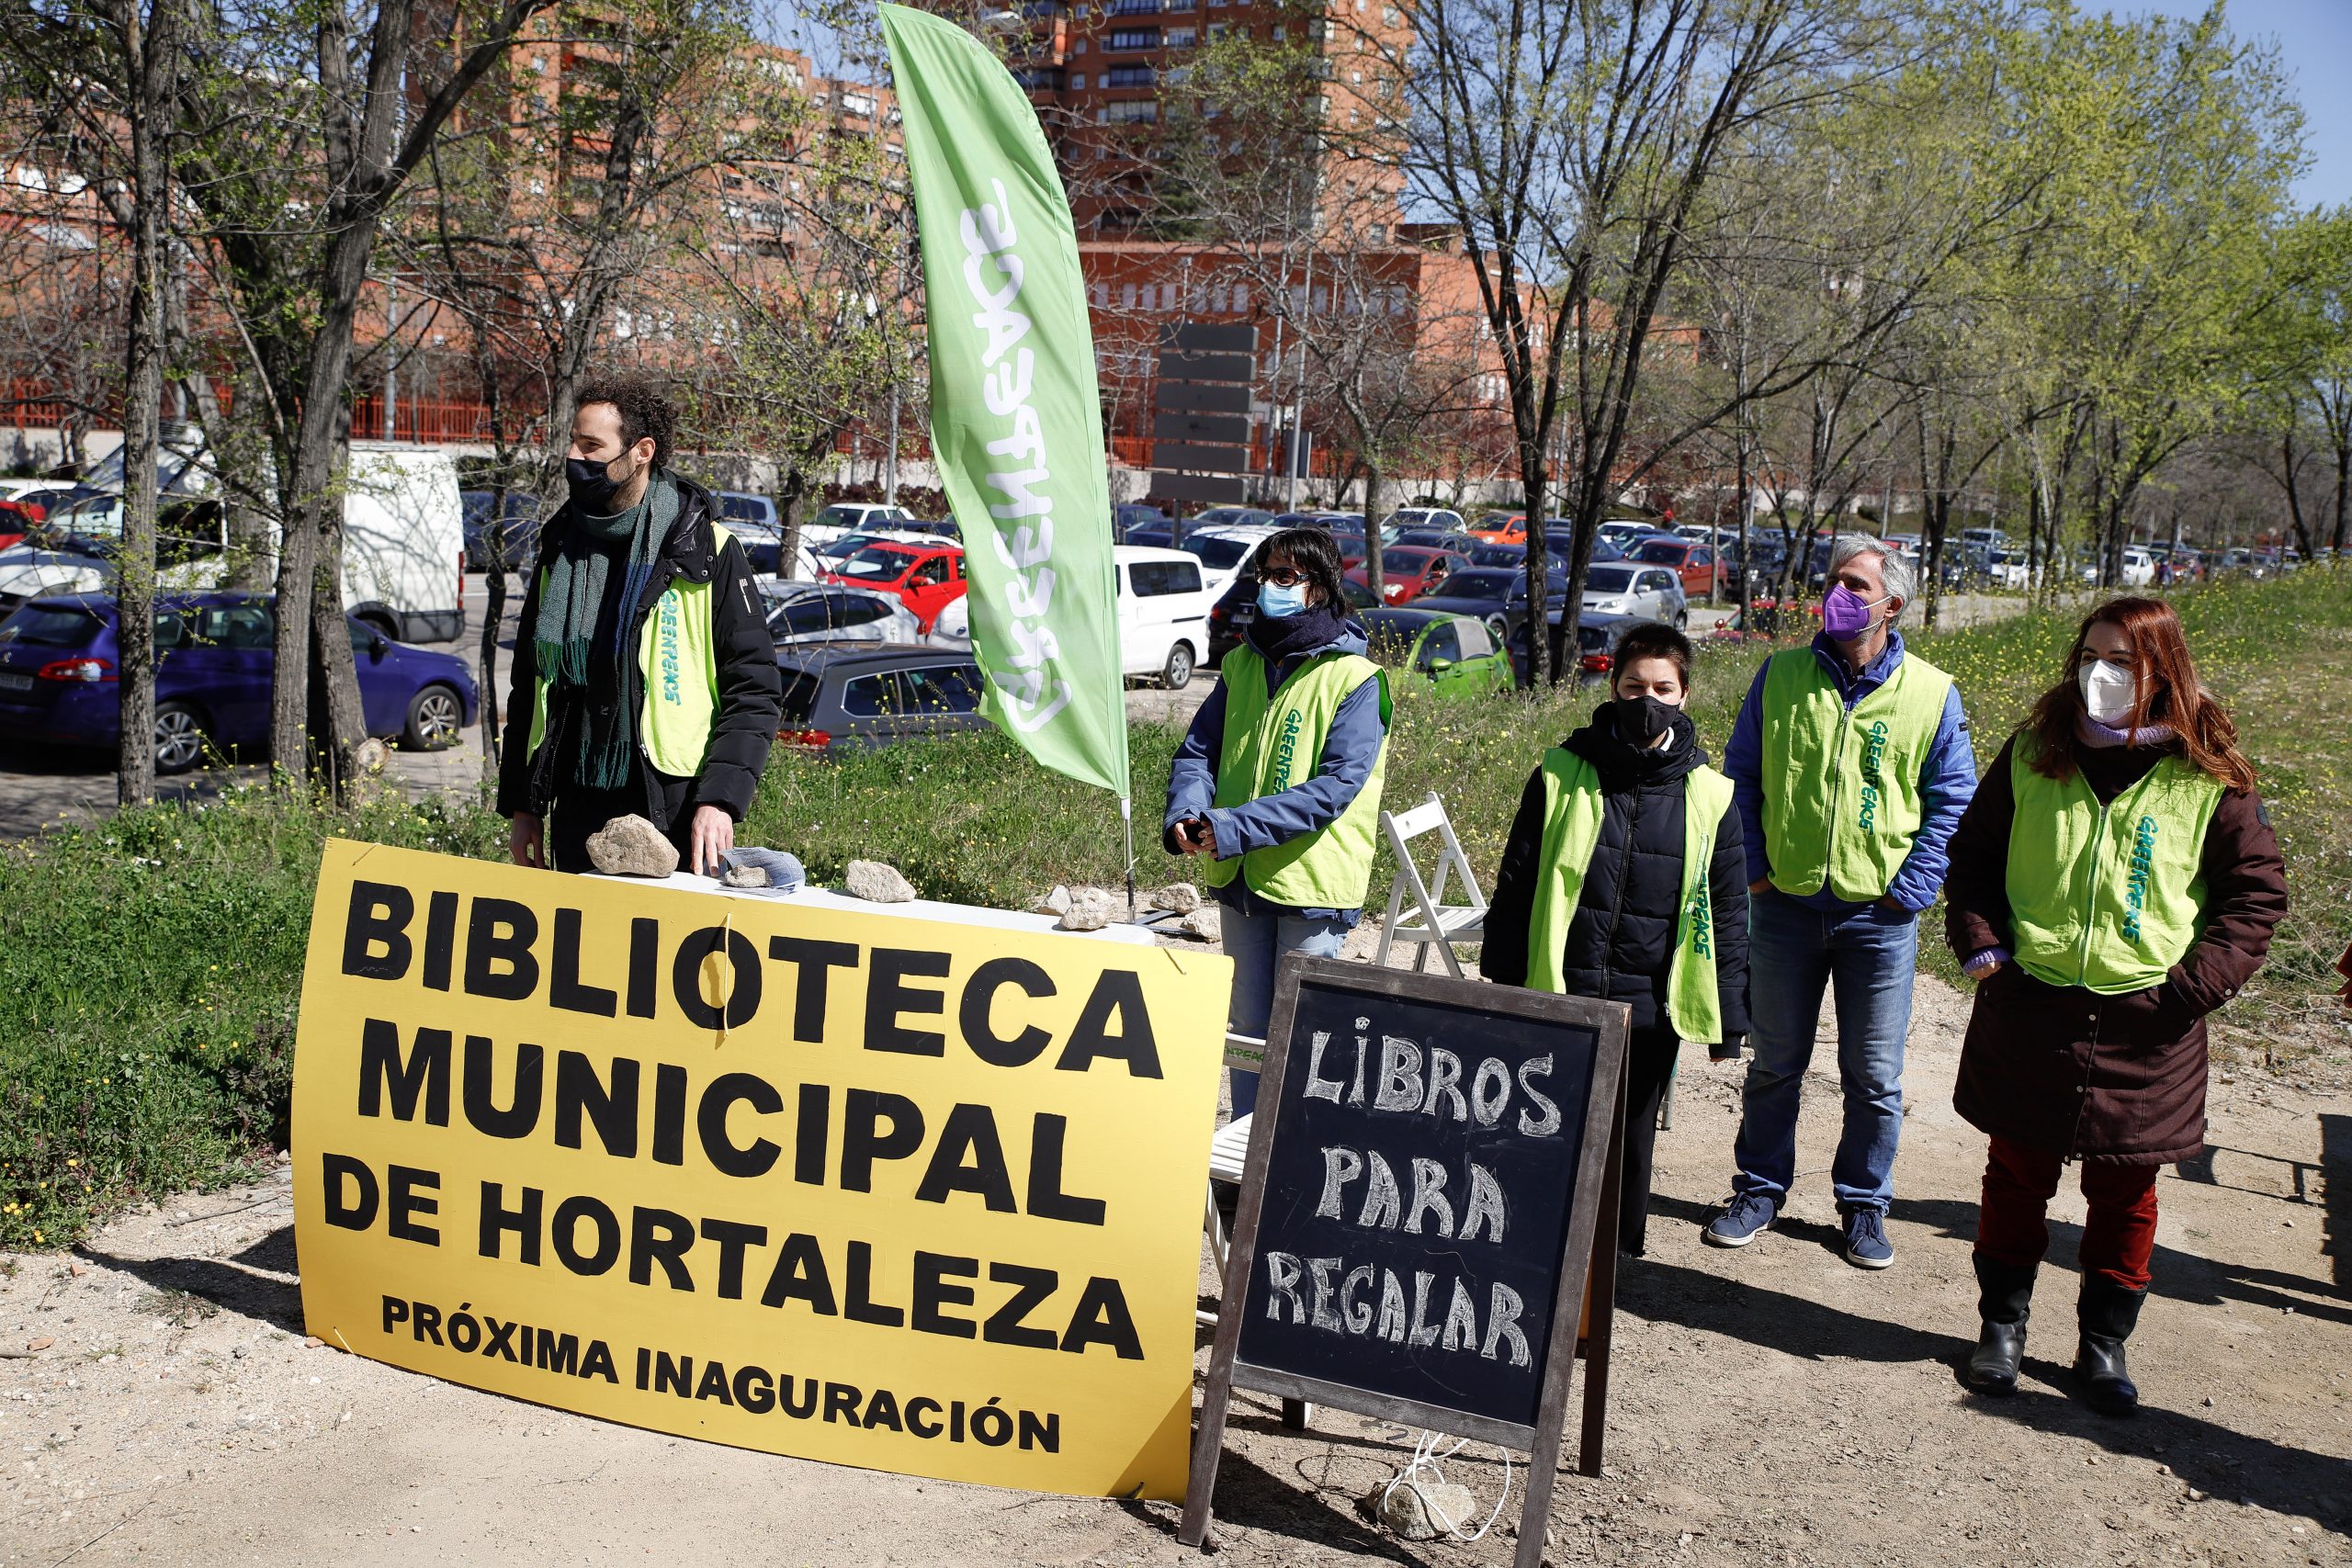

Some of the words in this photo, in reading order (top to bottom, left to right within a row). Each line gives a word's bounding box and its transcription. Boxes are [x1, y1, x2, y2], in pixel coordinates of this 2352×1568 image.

[661, 589, 682, 705] GREENPEACE
[1273, 708, 1303, 795] GREENPE
[1858, 720, 1889, 836] GREENPEACE
[2122, 816, 2159, 944] GREENPEACE
[342, 880, 1163, 1079] BIBLIOTECA
[358, 1018, 1105, 1225] MUNICIPAL
[1315, 1145, 1507, 1243] PARA
[322, 1153, 441, 1247] DE
[479, 1181, 1144, 1360] HORTALEZA
[1265, 1250, 1532, 1370] REGALAR
[382, 1295, 618, 1383] PRÓXIMA
[636, 1348, 1059, 1453] INAGURACIÓN
